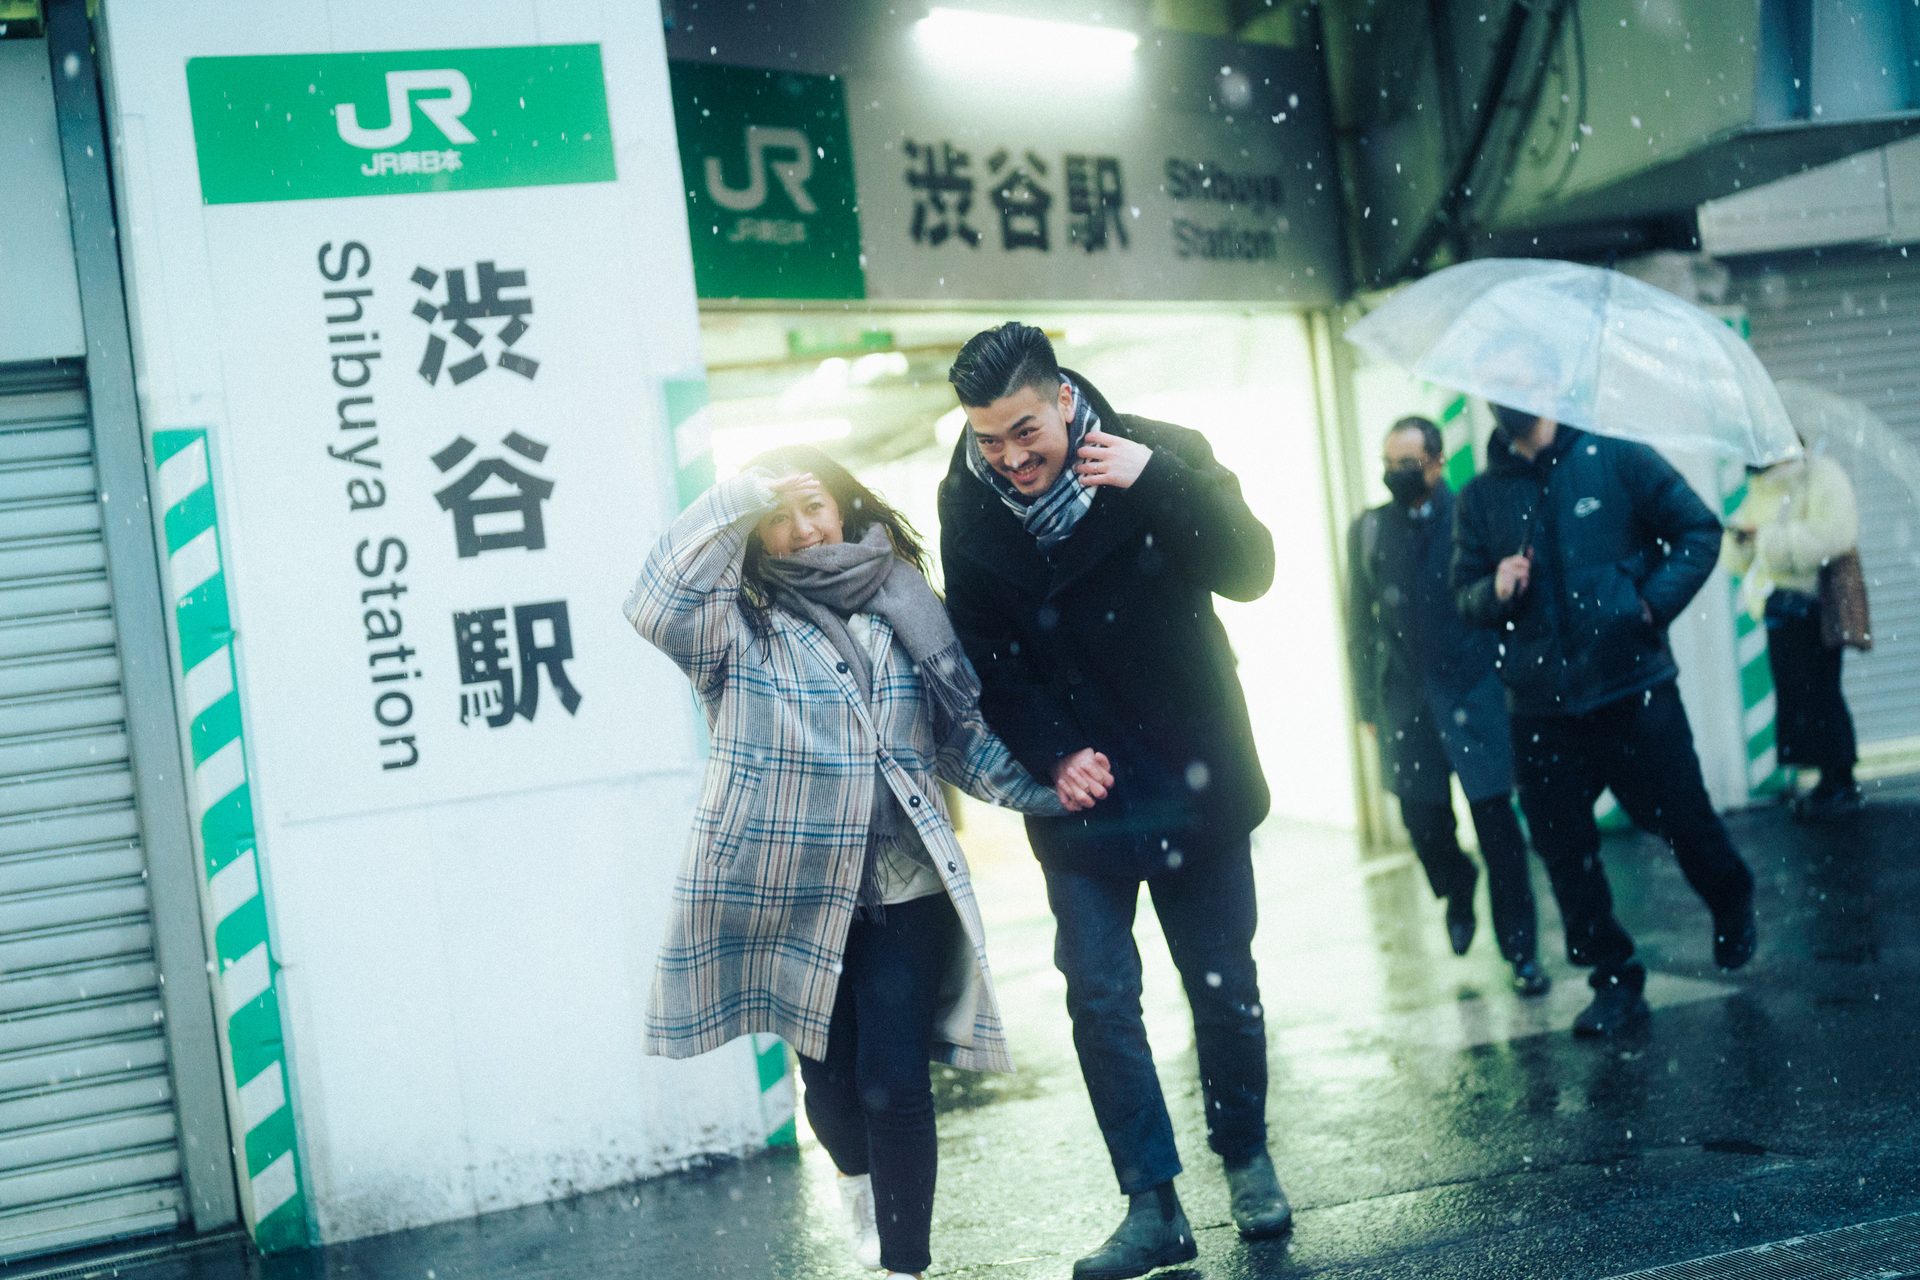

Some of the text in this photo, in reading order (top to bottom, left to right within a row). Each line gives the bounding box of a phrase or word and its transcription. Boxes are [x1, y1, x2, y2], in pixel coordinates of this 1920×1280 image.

[335, 67, 478, 149] JR
[360, 149, 463, 177] JR東日本
[704, 126, 818, 213] JR
[903, 138, 1133, 254] 渋谷駅
[317, 240, 422, 771] Shibuya Station
[410, 260, 582, 729] 渋谷駅
